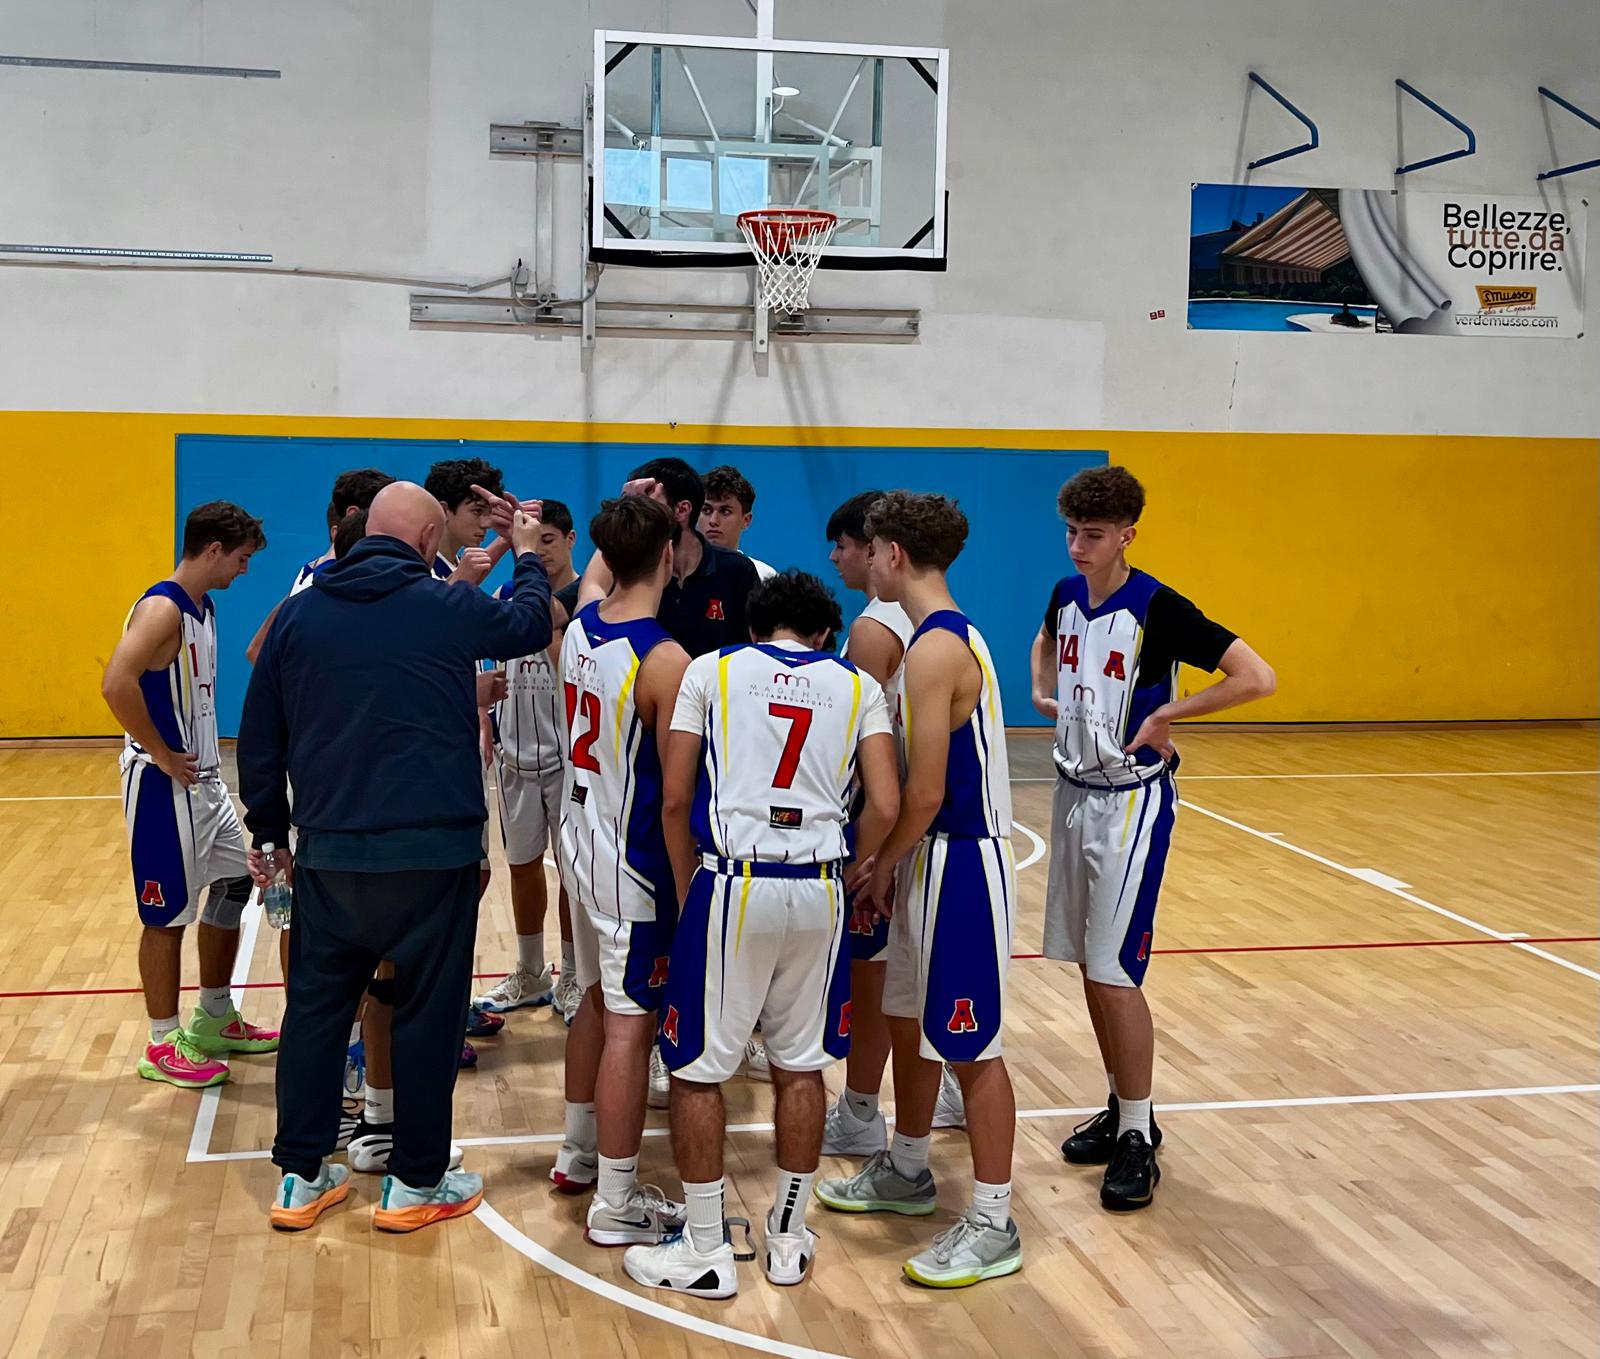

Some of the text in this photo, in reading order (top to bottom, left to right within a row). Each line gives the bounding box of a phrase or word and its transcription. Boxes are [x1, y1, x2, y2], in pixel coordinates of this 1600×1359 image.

[1443, 203, 1571, 235] Bellezze,
[1446, 226, 1564, 252] tutte da
[1447, 244, 1563, 275] Coprire.
[1455, 315, 1559, 329] verdemusso.com
[1058, 634, 1079, 673] 14
[1103, 650, 1126, 681] A
[563, 681, 601, 776] 12
[768, 702, 813, 790] 7
[141, 880, 165, 908] A
[947, 998, 978, 1034] A
